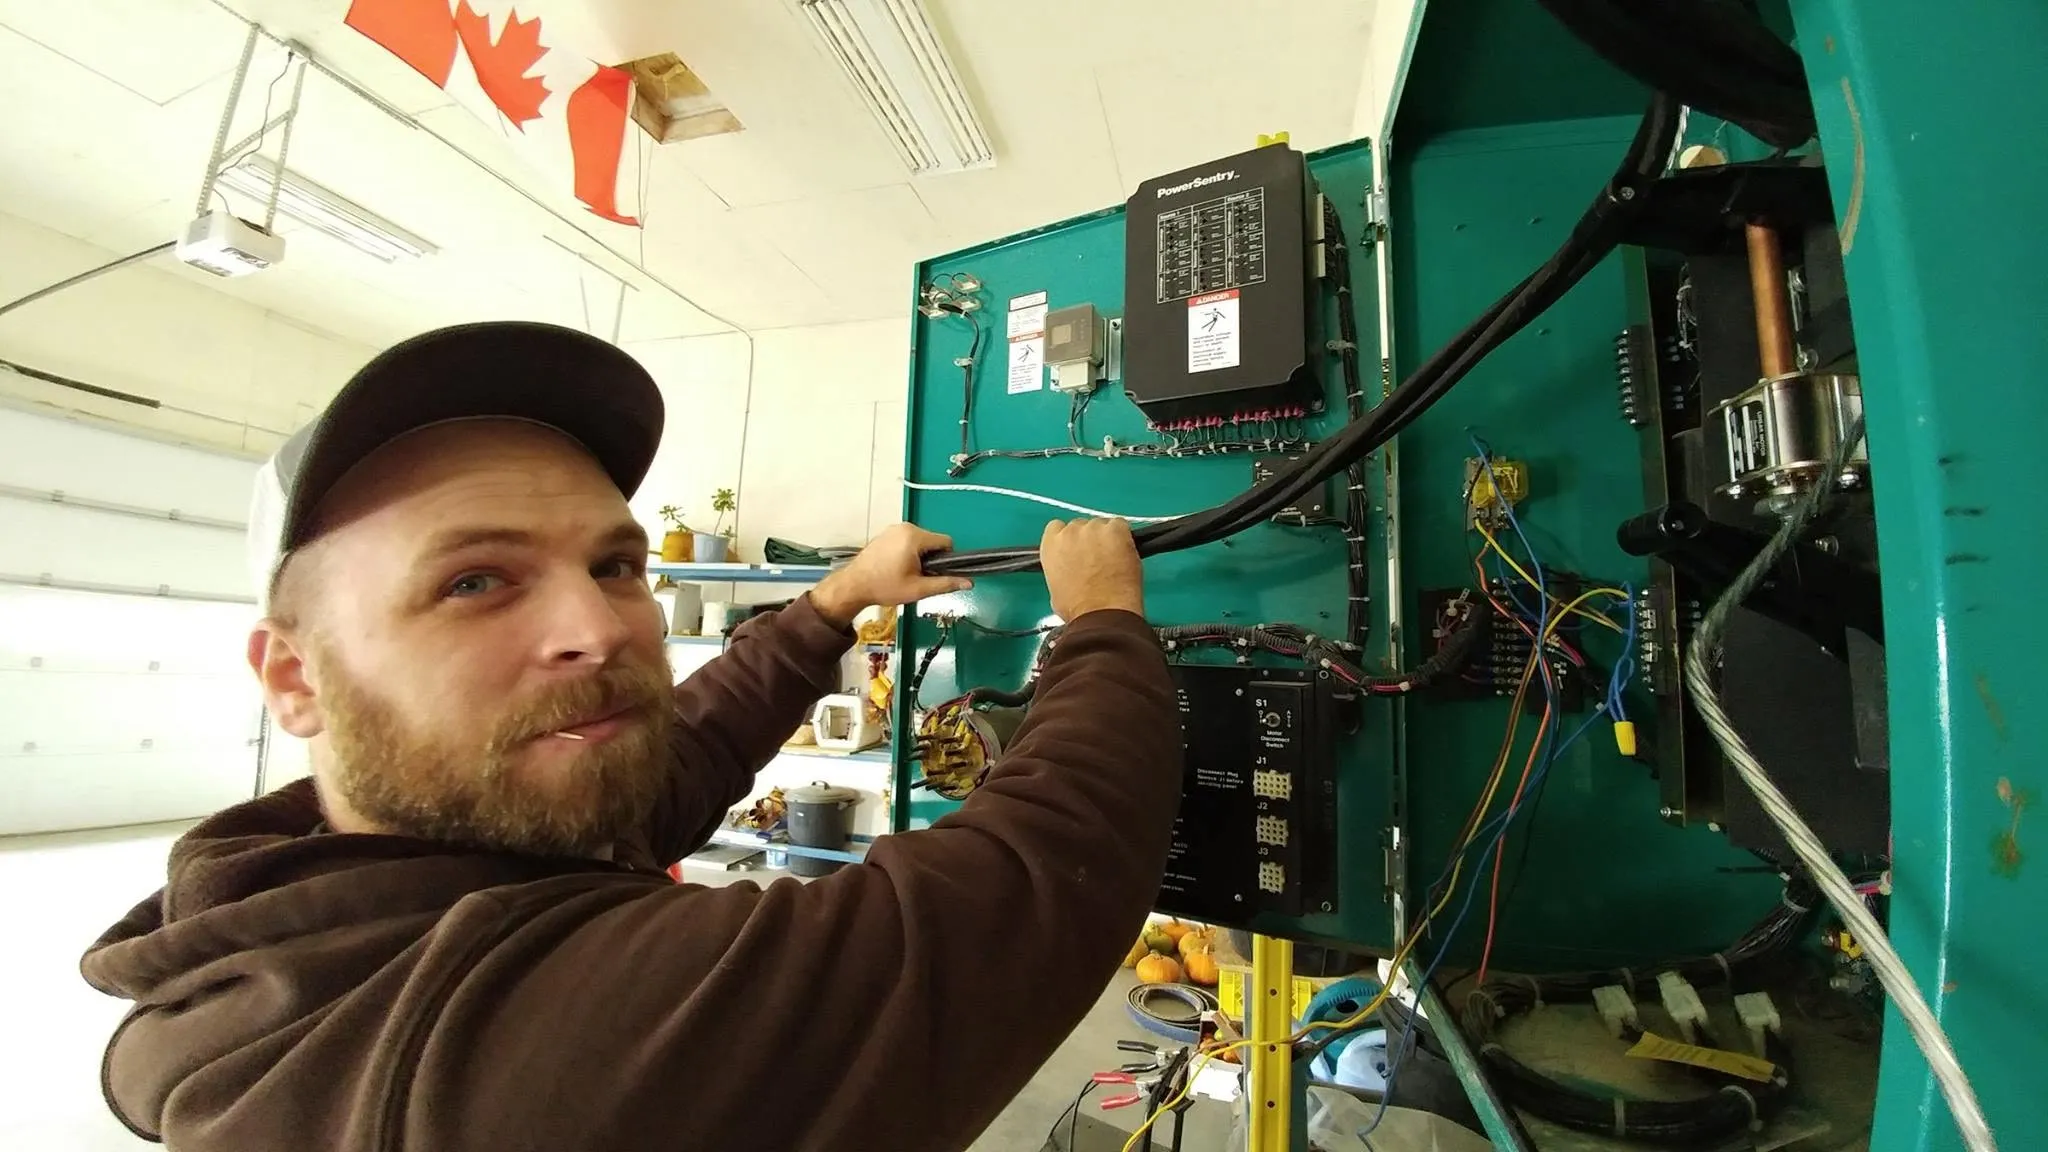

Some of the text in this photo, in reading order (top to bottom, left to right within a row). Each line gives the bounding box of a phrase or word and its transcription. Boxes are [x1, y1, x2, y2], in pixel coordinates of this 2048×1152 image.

[1157, 170, 1235, 199] PowerSentry
[1255, 698, 1267, 707] S1
[1260, 735, 1290, 743] Disconnect
[1265, 741, 1284, 749] Switch
[1256, 756, 1267, 765] J1
[1256, 801, 1268, 810] J2
[1257, 847, 1269, 856] J3
